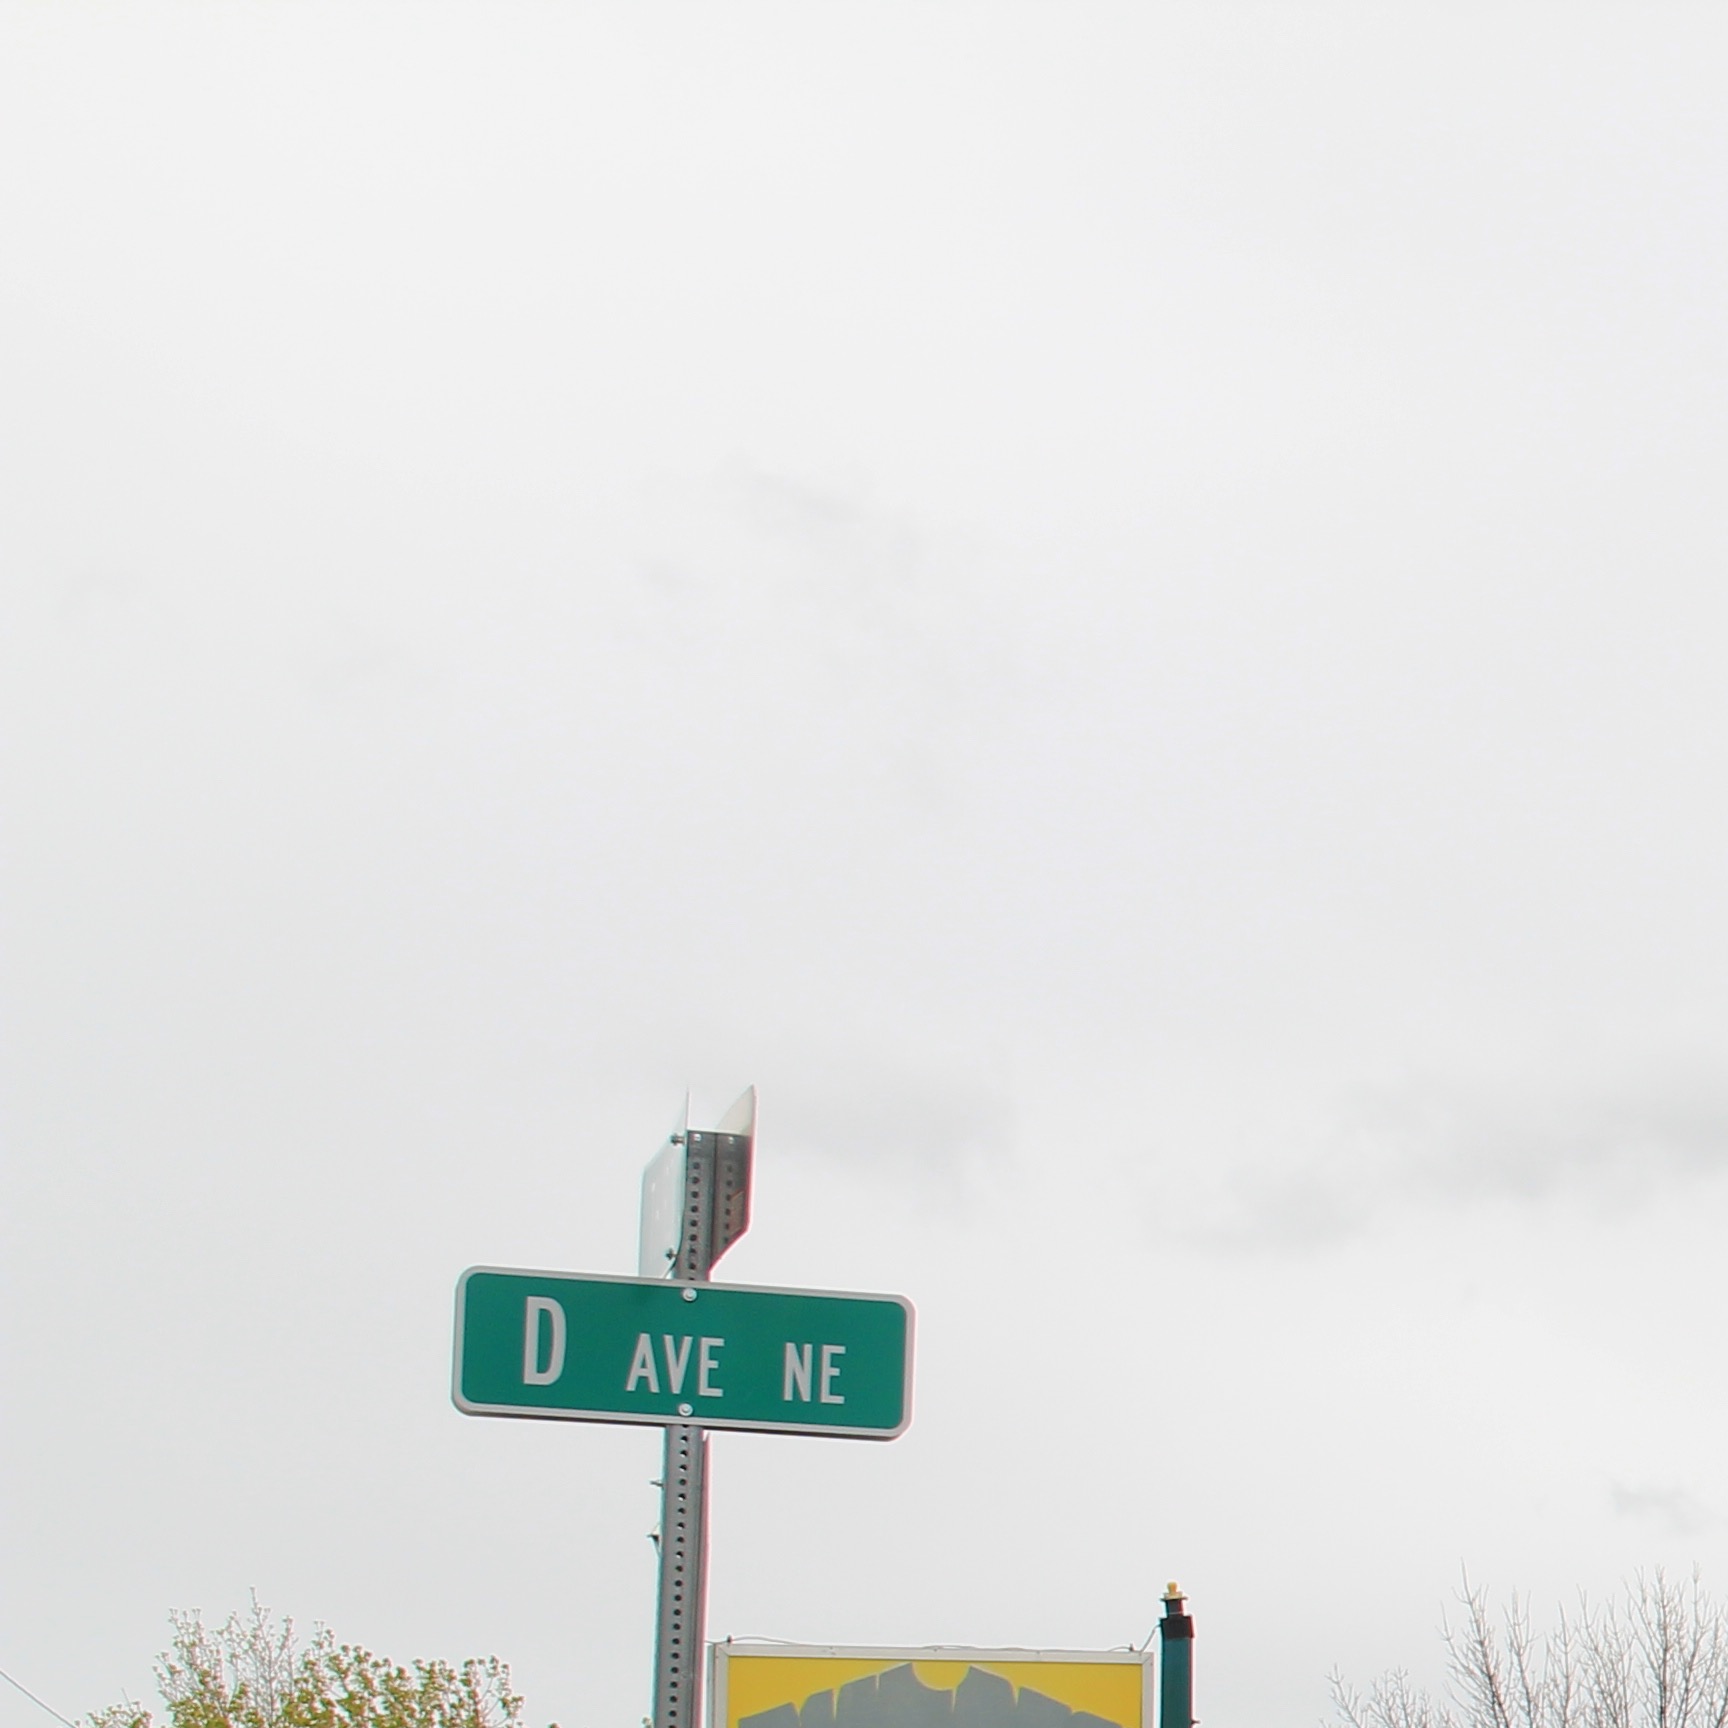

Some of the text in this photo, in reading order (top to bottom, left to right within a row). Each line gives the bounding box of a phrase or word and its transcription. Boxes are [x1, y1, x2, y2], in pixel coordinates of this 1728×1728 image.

[523, 1295, 847, 1405] D AVE NE
